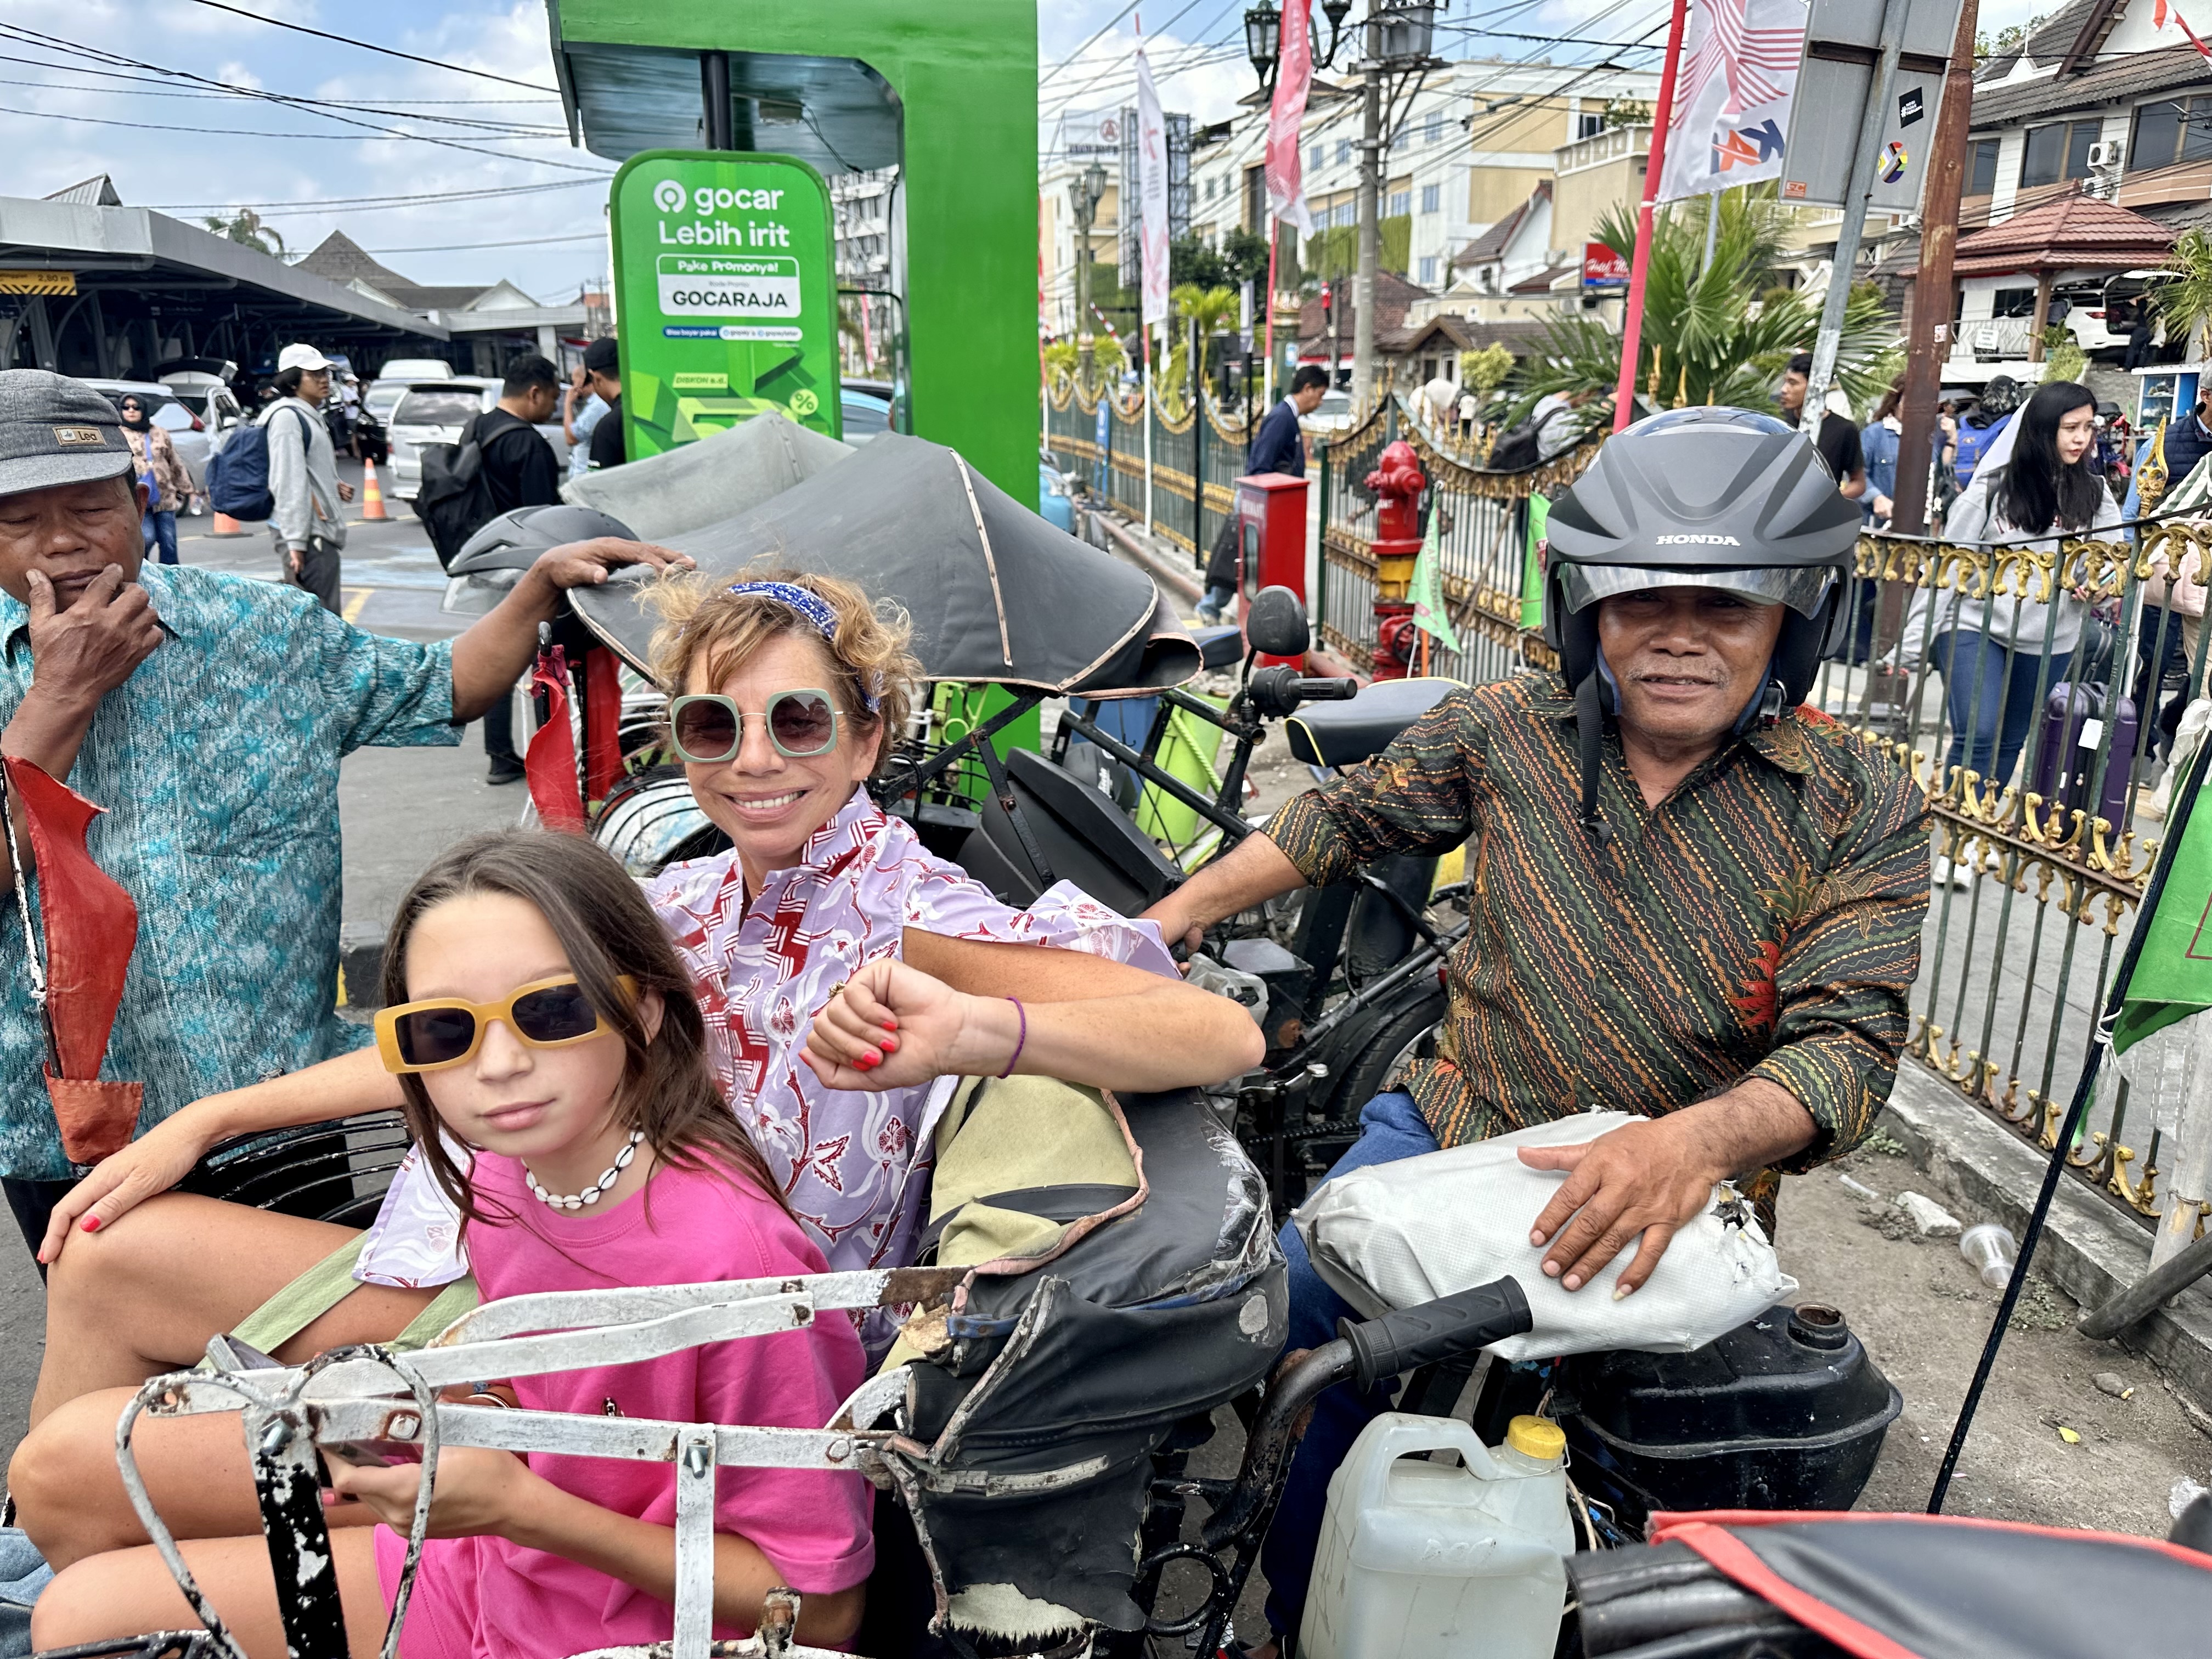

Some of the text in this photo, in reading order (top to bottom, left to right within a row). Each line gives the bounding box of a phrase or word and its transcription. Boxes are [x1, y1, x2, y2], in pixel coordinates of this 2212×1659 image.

[694, 187, 784, 216] gocar
[659, 221, 790, 247] Lebih irit
[678, 260, 778, 275] Pake Promonya!
[673, 291, 788, 308] GOCARAJA
[78, 431, 98, 440] Lea
[1655, 534, 1741, 546] HONDA
